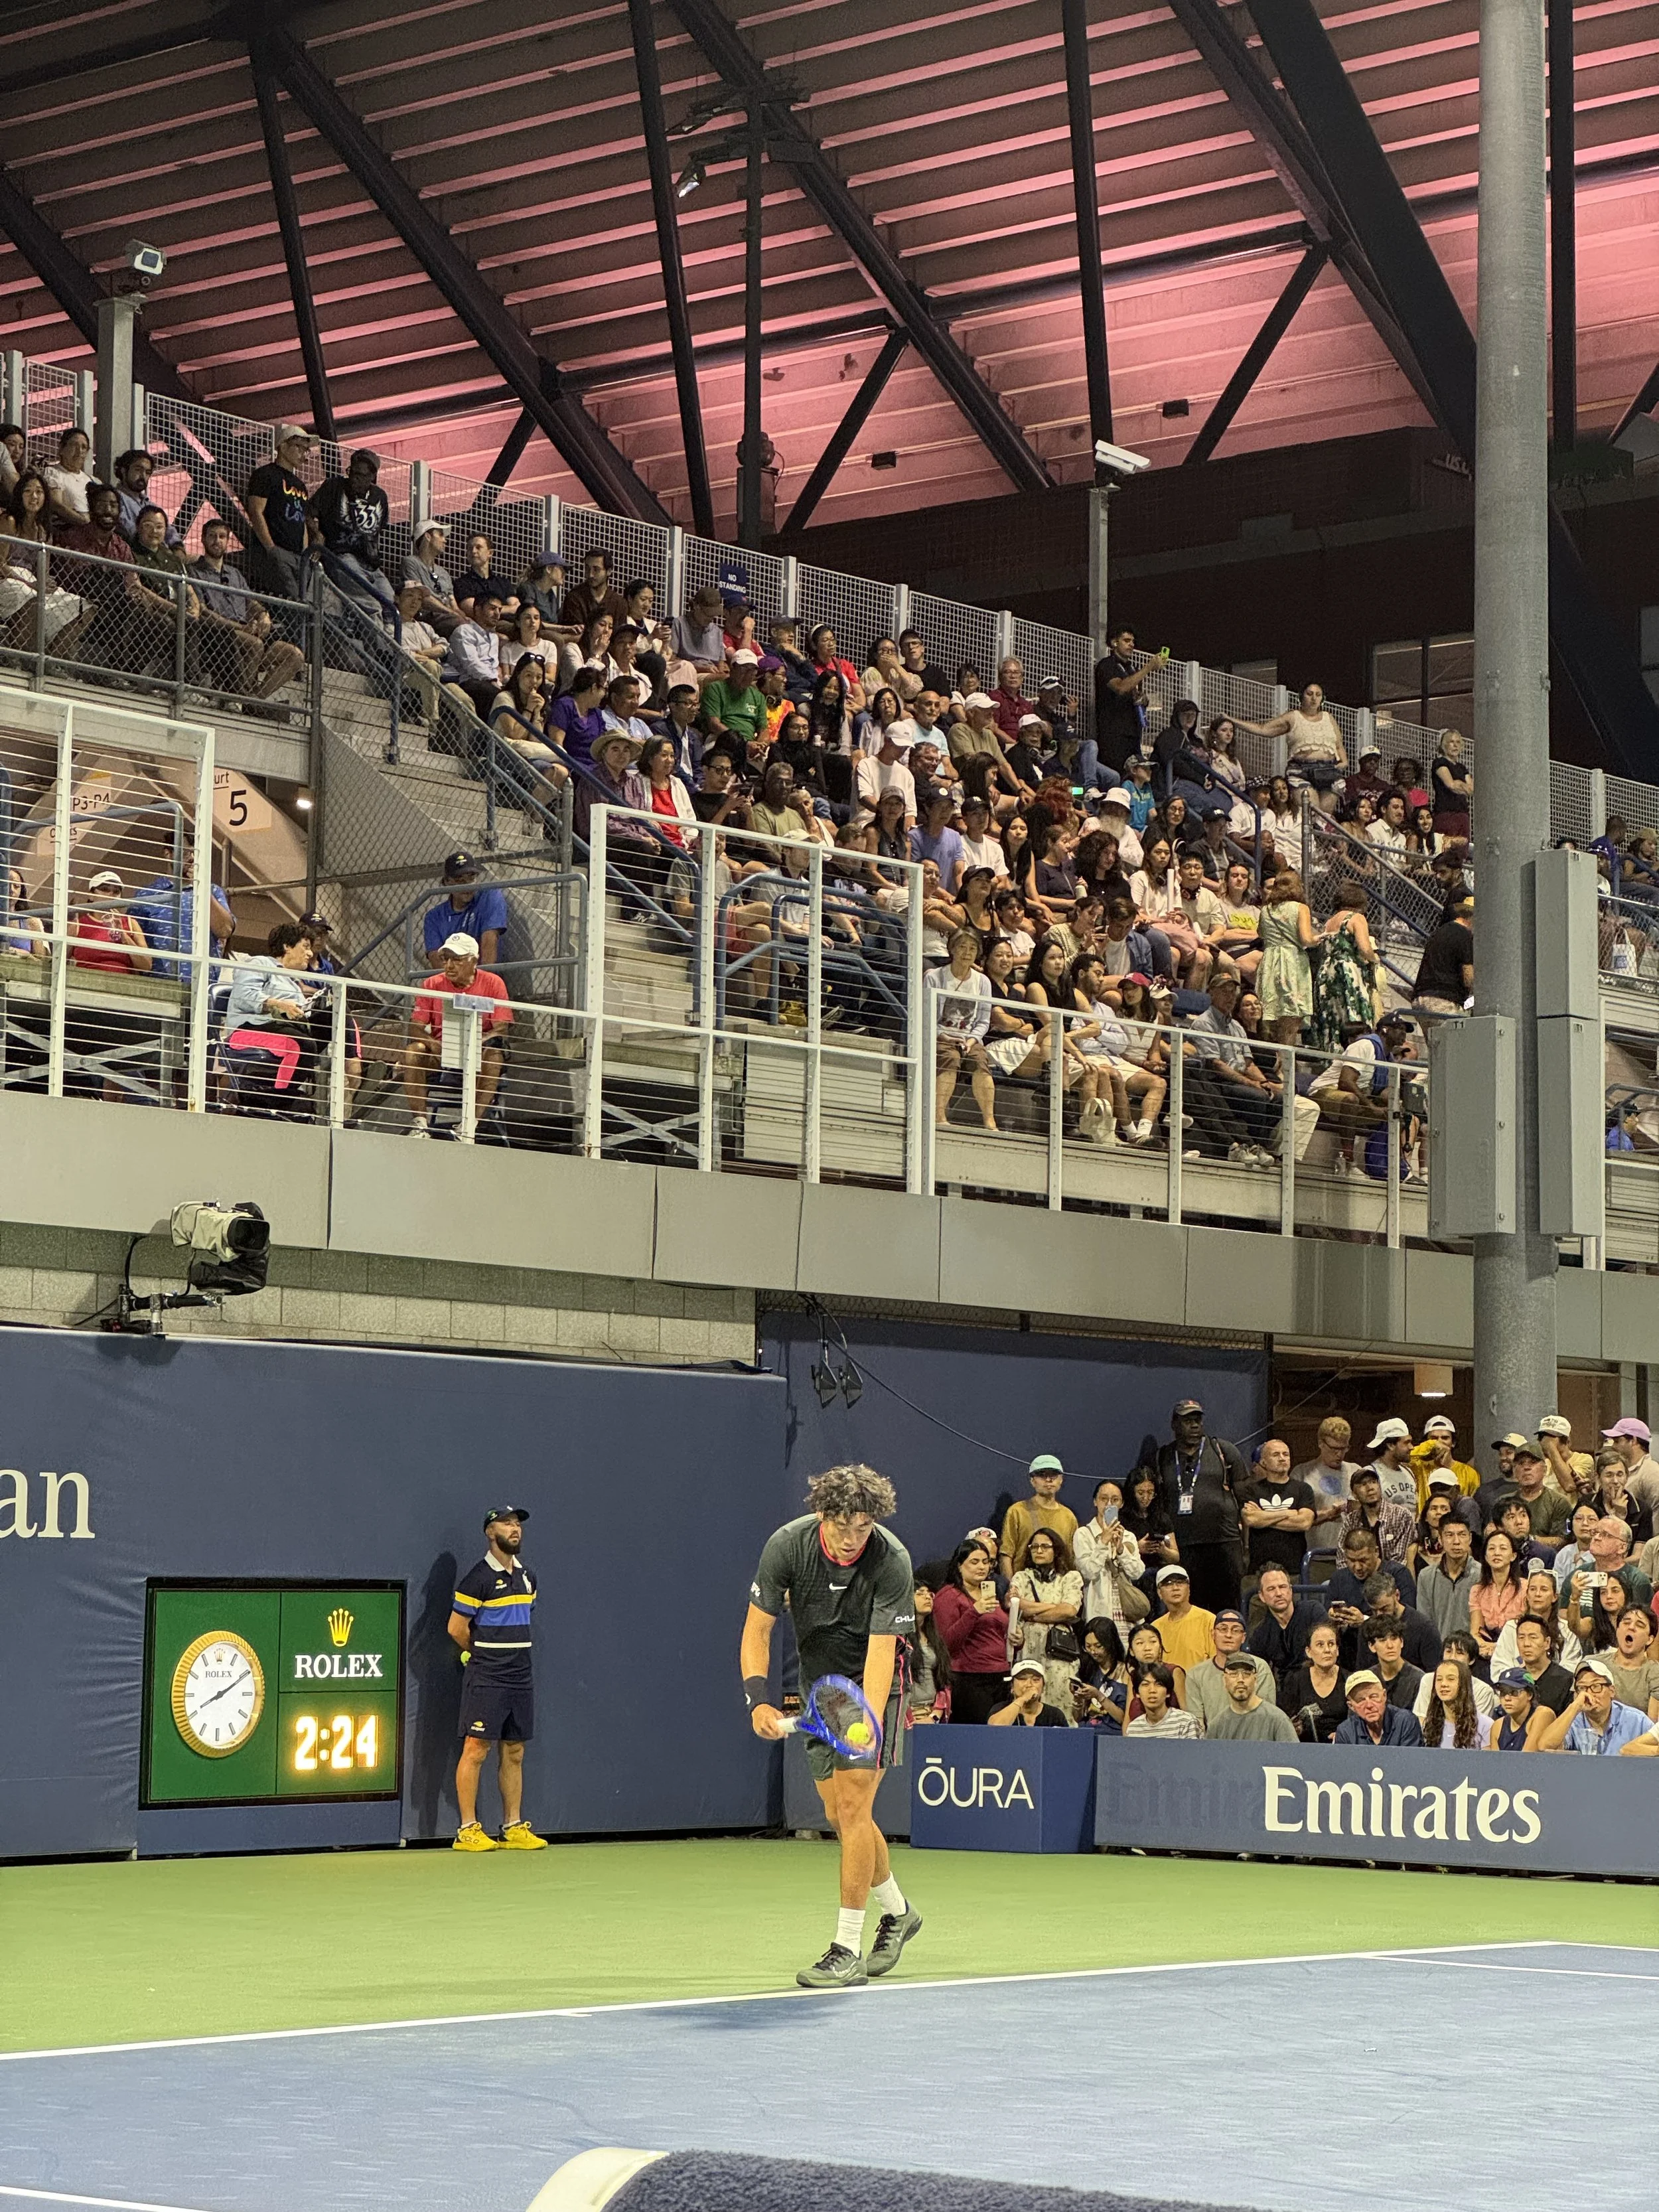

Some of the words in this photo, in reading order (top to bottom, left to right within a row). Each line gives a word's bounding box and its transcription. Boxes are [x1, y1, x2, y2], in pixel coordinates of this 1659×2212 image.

[719, 581, 747, 594] STANDING
[727, 573, 737, 582] NO
[214, 771, 230, 784] urt
[73, 792, 109, 811] P3-P4
[229, 790, 248, 826] 5
[1384, 1484, 1398, 1498] US
[1399, 1482, 1415, 1493] OPE
[294, 1654, 384, 1678] ROLEX
[295, 1715, 378, 1770] 2:24
[918, 1757, 1035, 1809] ŌURA
[1262, 1766, 1542, 1844] Emirates
